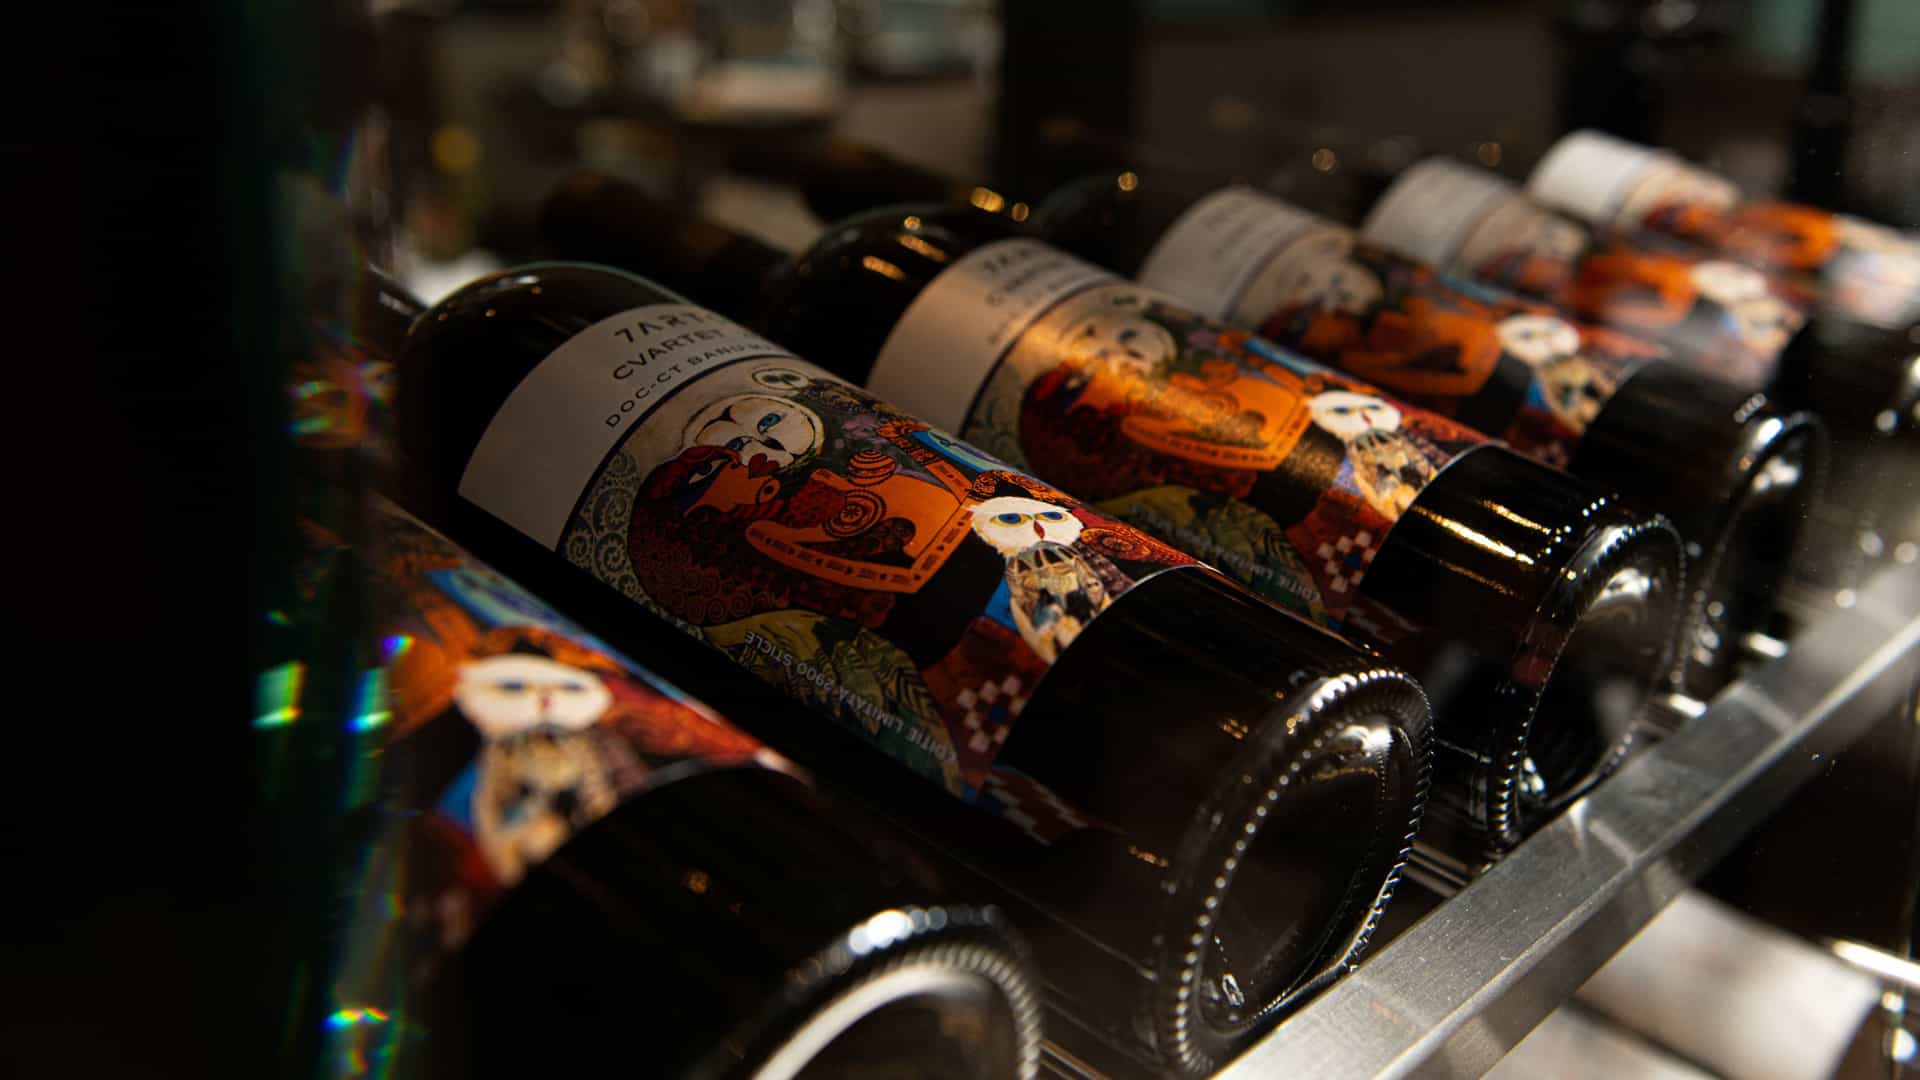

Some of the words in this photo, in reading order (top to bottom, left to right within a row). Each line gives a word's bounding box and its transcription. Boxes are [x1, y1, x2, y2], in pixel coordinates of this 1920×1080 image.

[614, 311, 722, 343] 7ART
[613, 328, 726, 380] CVARTET
[605, 365, 682, 428] DOC-CT
[745, 631, 793, 666] STICLE
[796, 662, 833, 692] 2900
